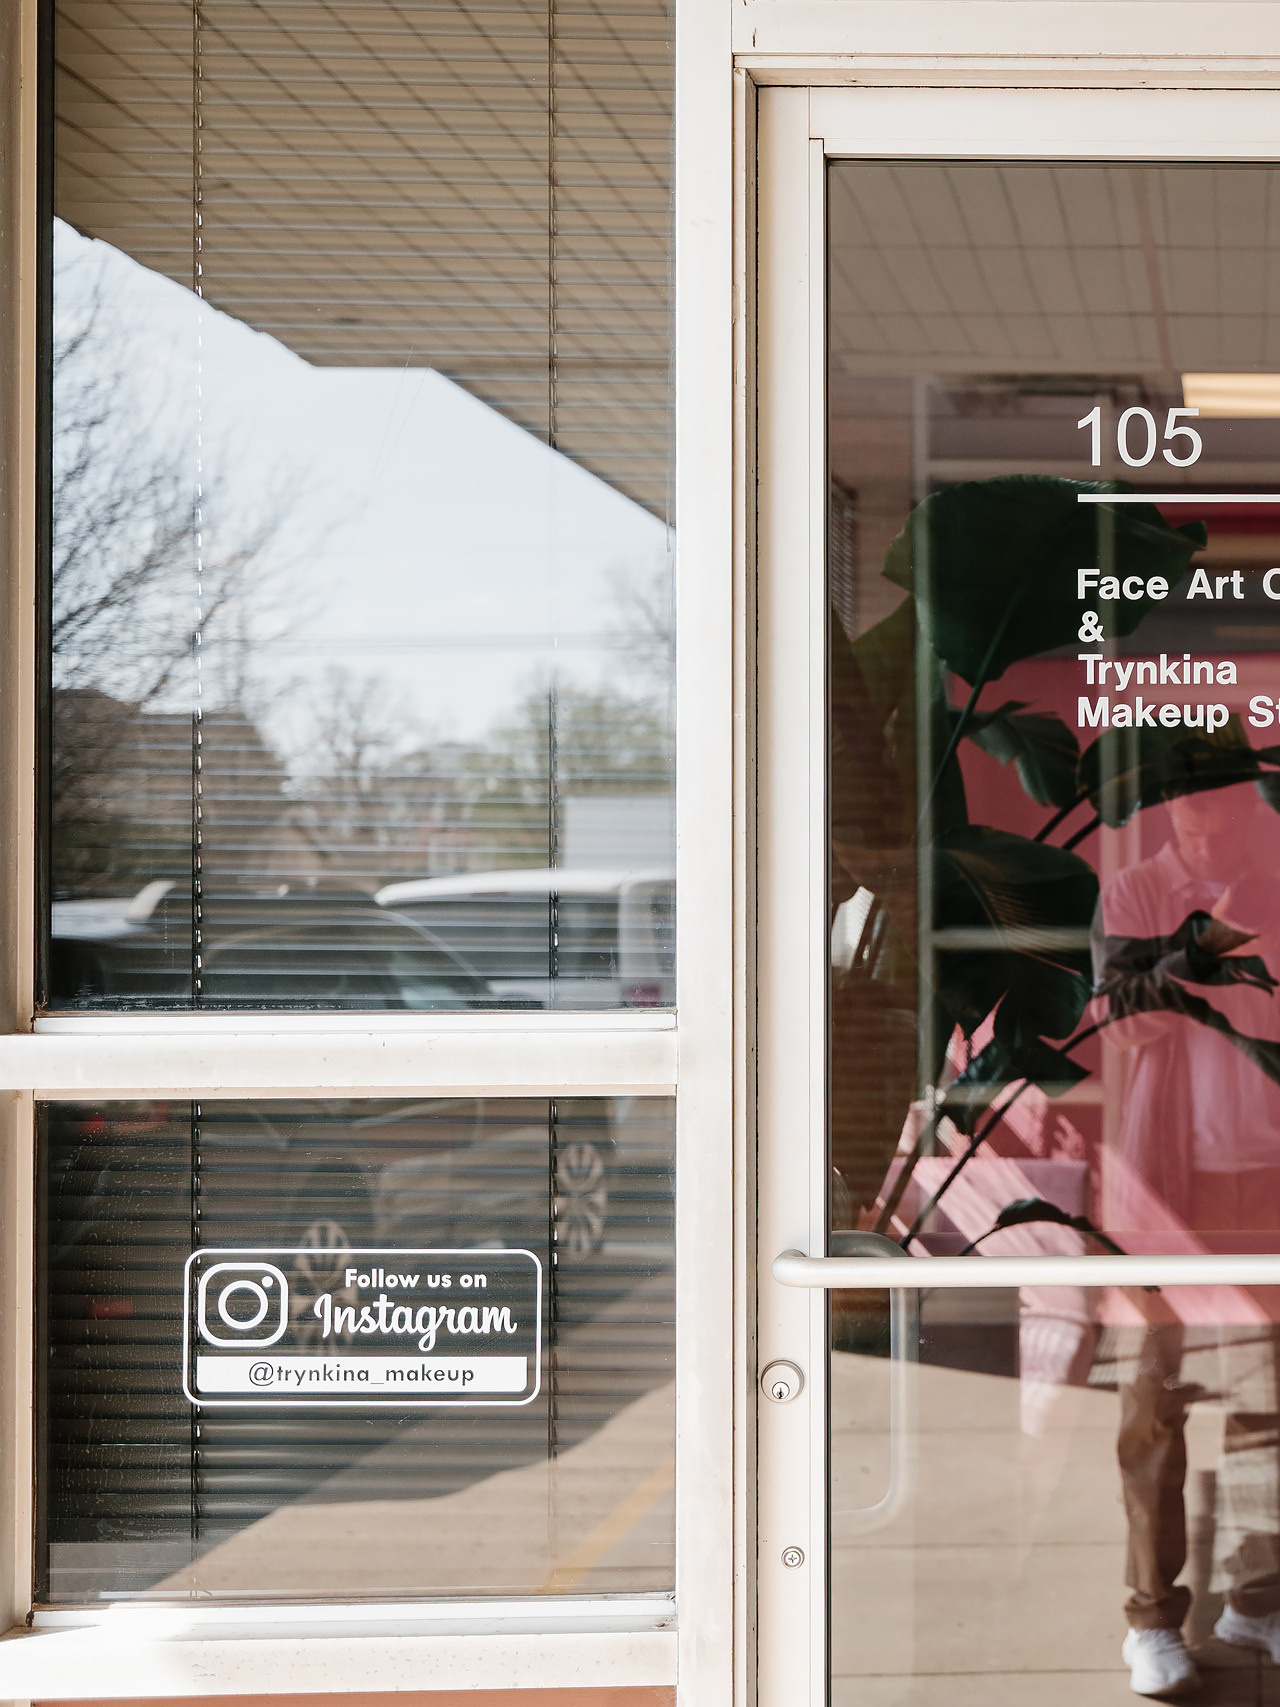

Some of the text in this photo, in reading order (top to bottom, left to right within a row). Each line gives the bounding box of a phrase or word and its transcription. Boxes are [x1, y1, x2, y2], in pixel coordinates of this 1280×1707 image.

[1078, 406, 1202, 467] 105
[1078, 569, 1168, 600] Face
[1187, 569, 1244, 599] Art
[1078, 611, 1105, 642] &
[1078, 654, 1237, 691] Trynkina
[1078, 697, 1229, 733] Makeup
[346, 1269, 486, 1288] Follow us on
[314, 1294, 517, 1351] Instagram
[248, 1361, 475, 1387] @trynkina_makeup
